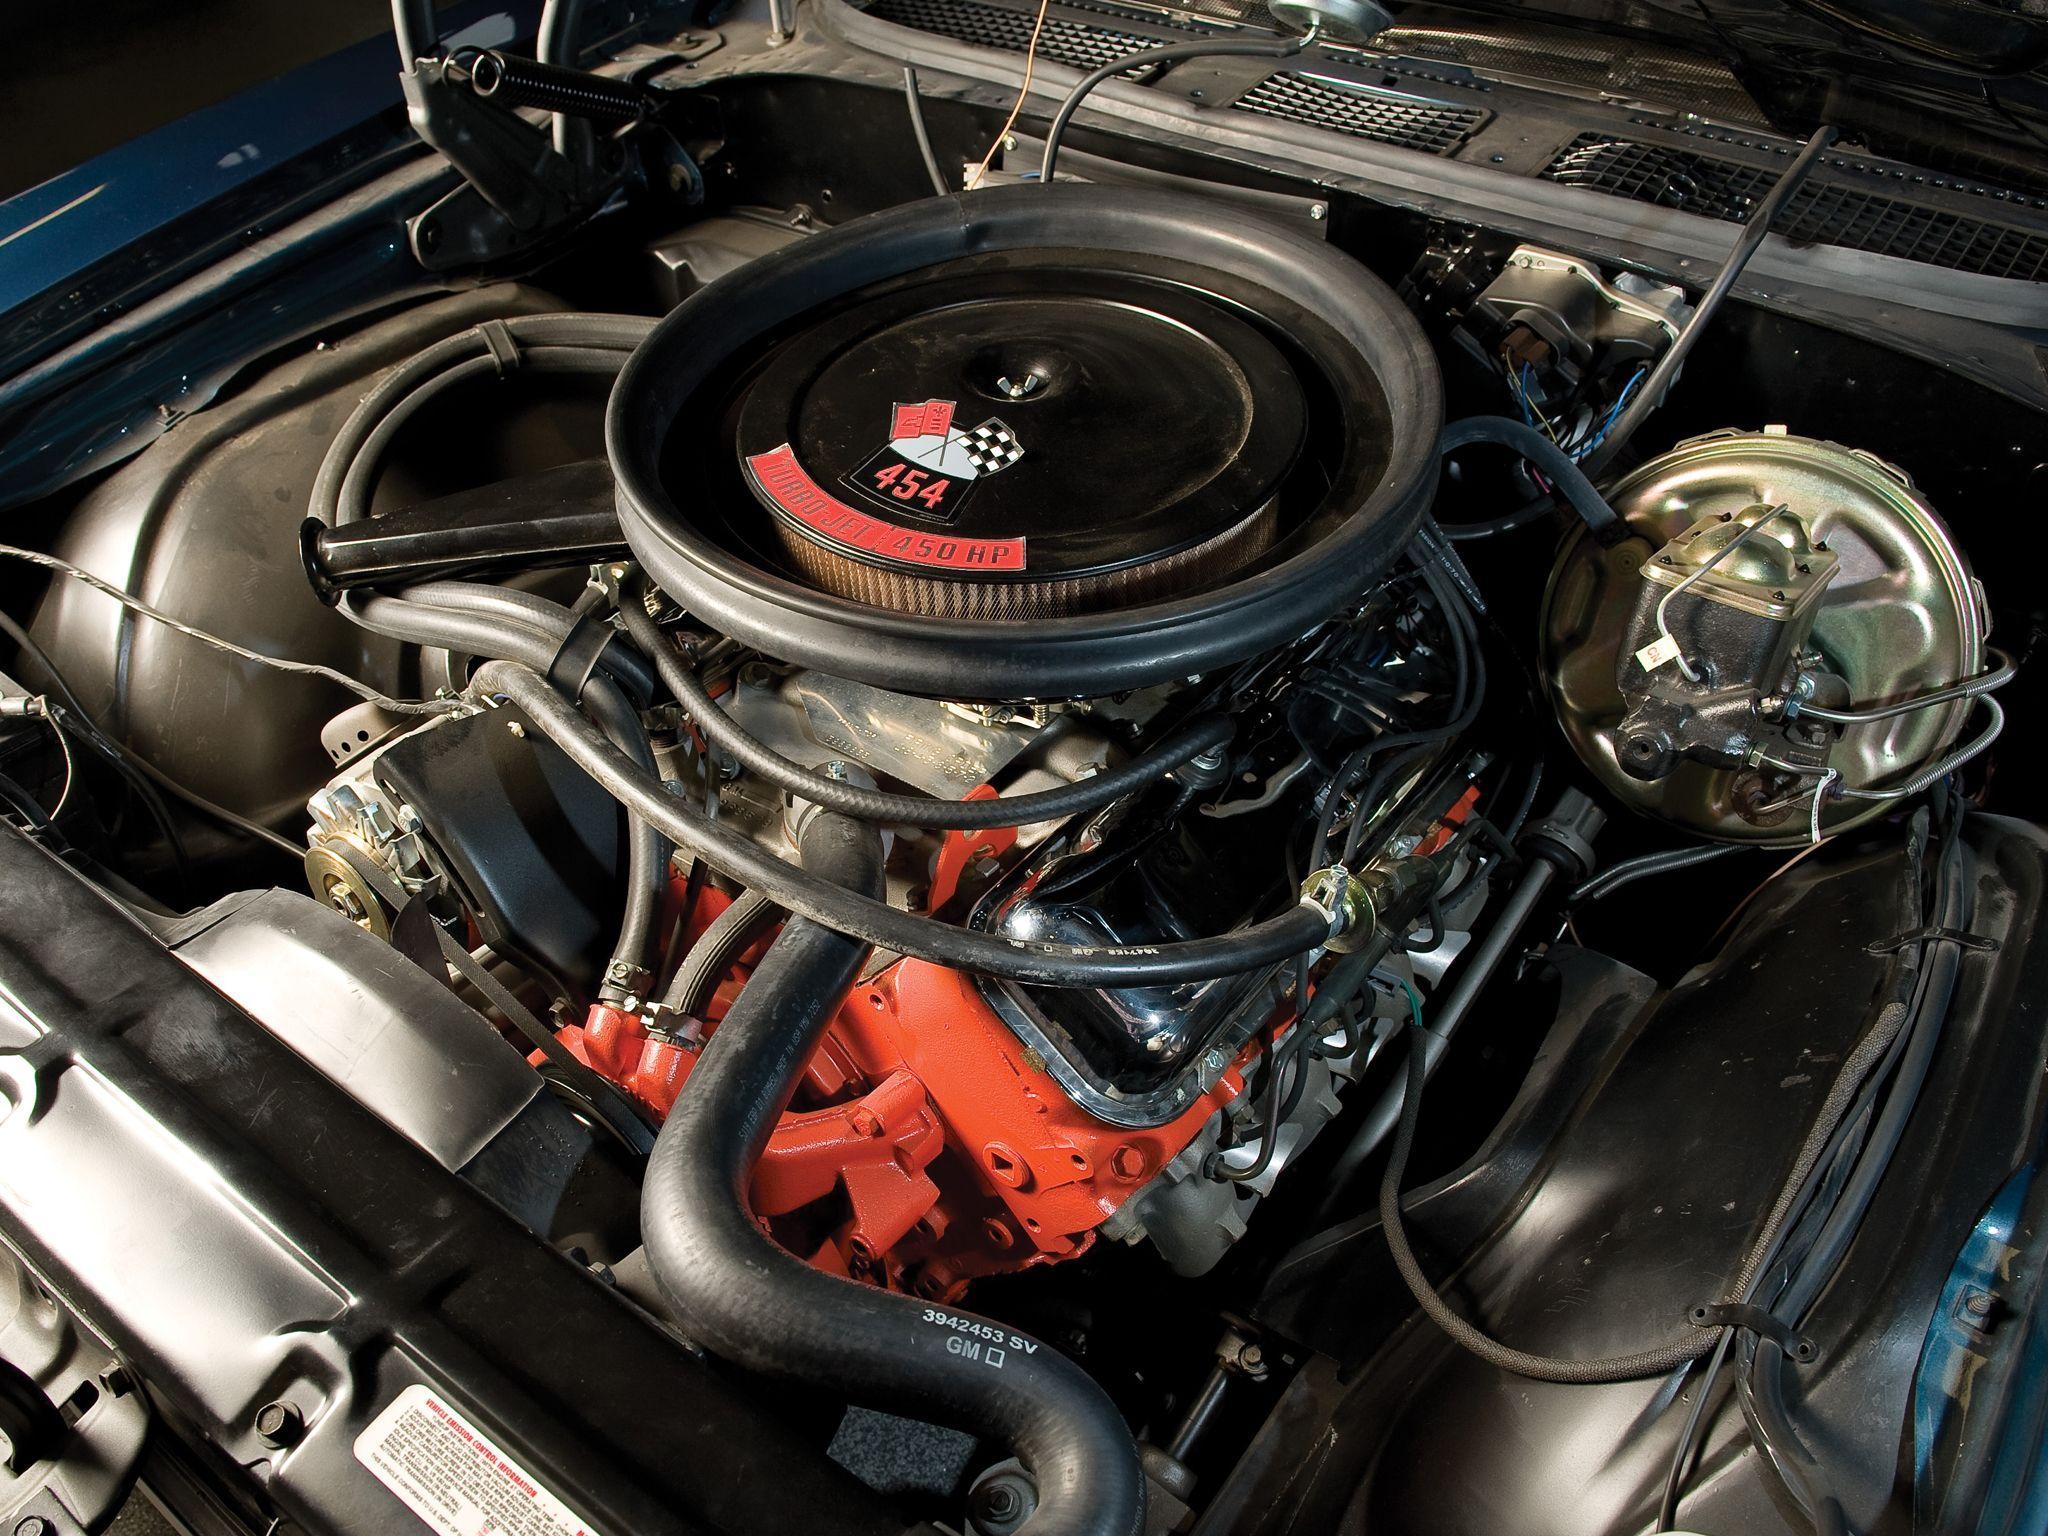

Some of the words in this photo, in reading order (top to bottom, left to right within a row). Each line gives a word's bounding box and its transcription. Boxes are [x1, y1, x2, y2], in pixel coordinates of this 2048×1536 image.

[874, 463, 951, 509] 454
[893, 536, 958, 560] 450
[966, 543, 1010, 564] HP
[922, 1309, 1004, 1343] 3942453
[1009, 1336, 1039, 1354] SV
[946, 1336, 980, 1361] GM
[425, 1398, 448, 1420] VEHICLE
[445, 1416, 474, 1442] EMISSION
[471, 1439, 498, 1464] CONTROL
[496, 1461, 537, 1498] INFORMATION
